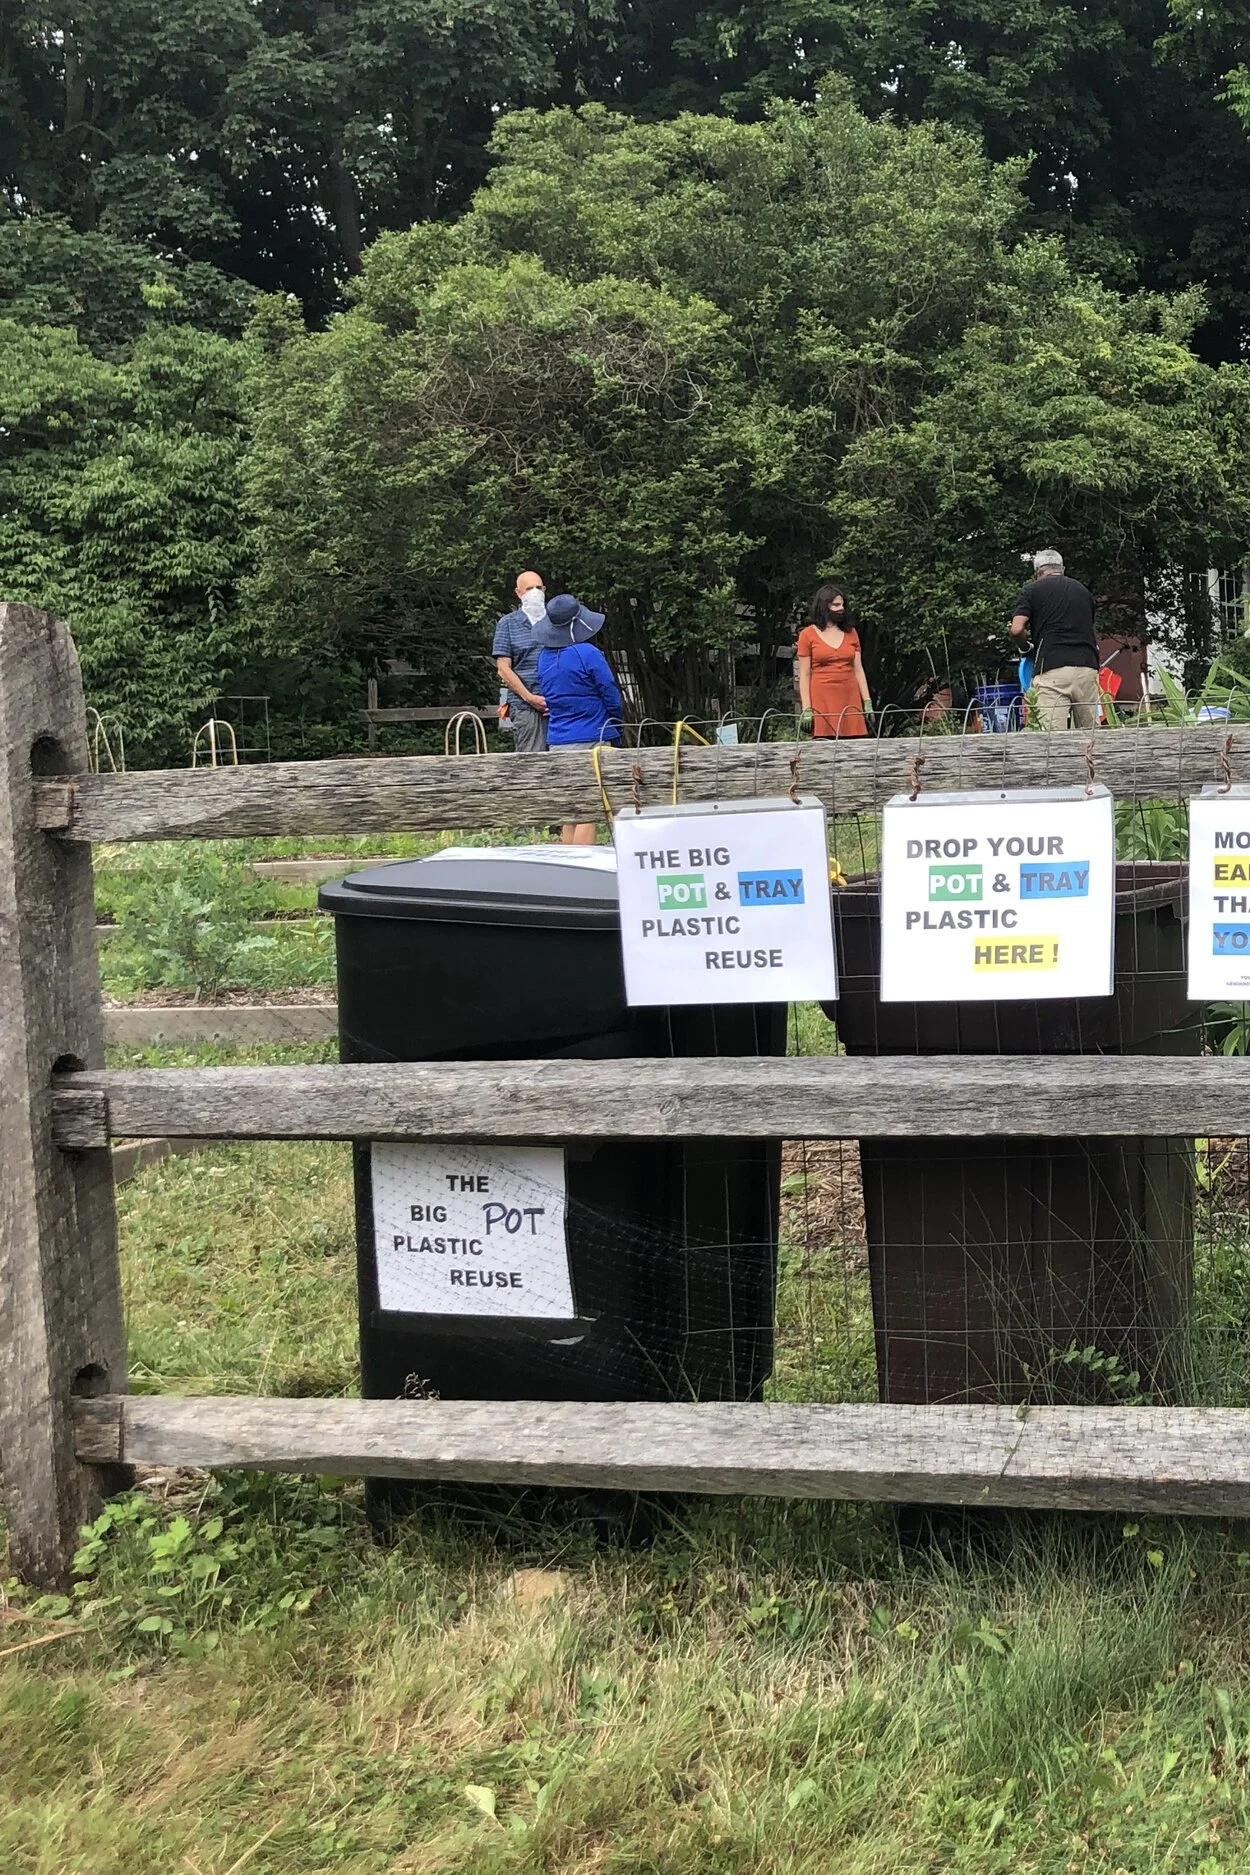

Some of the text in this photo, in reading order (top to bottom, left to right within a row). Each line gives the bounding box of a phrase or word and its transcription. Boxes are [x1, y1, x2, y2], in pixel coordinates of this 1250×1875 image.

[635, 847, 730, 869] THE BIG
[906, 836, 1063, 859] DROP YOUR
[659, 878, 804, 904] POT & TRAY
[929, 870, 1089, 895] POT & TRAY
[642, 916, 741, 938] PLASTIC
[906, 909, 1018, 930] PLASTIC
[705, 949, 783, 970] REUSE
[974, 944, 1044, 965] HERE
[446, 1175, 489, 1193] THE
[411, 1205, 447, 1223] BIG
[482, 1202, 545, 1235] POT
[393, 1236, 484, 1256] PLASTIC
[451, 1269, 524, 1289] REUSE
